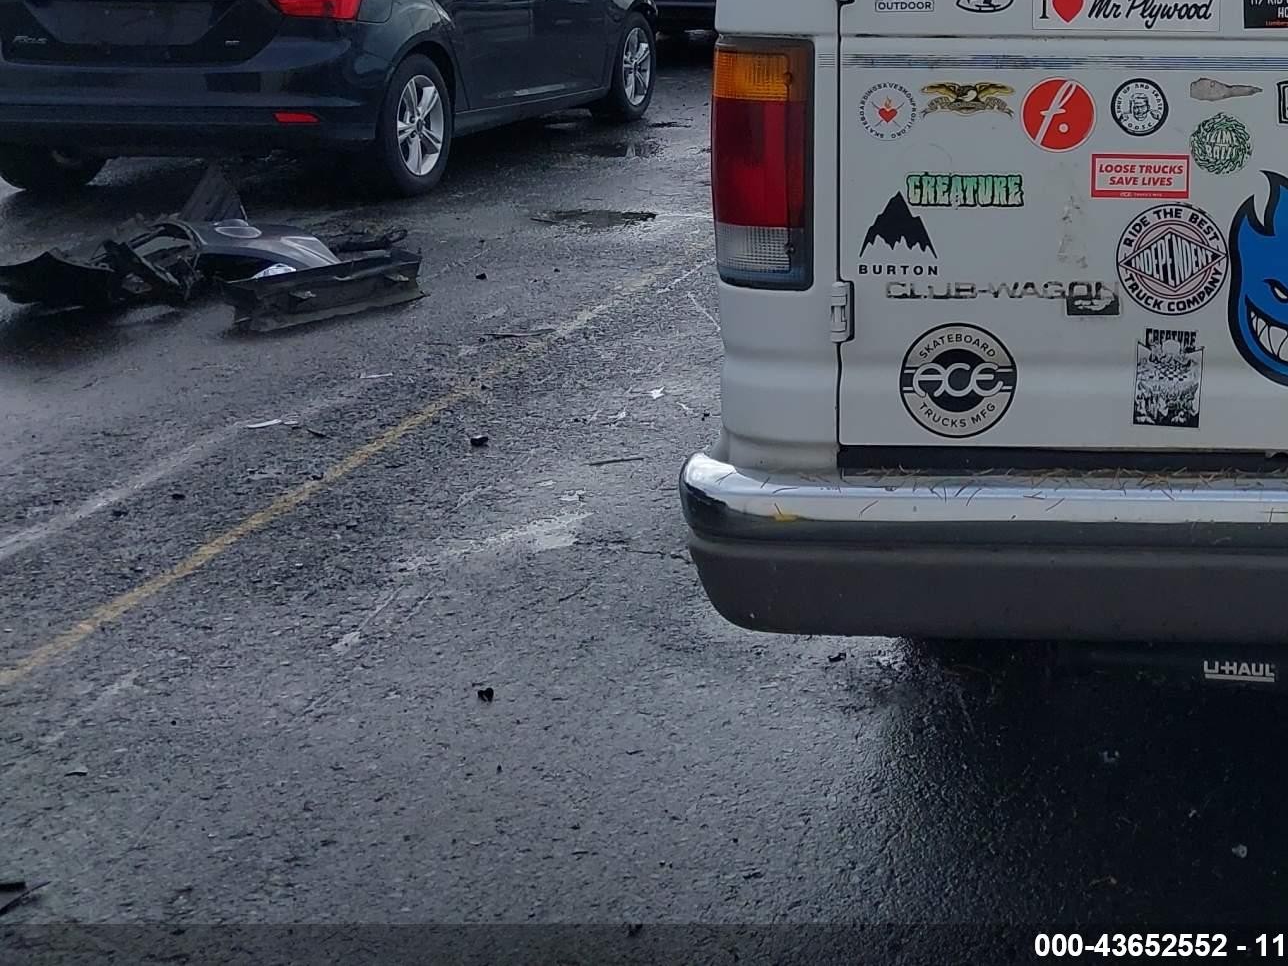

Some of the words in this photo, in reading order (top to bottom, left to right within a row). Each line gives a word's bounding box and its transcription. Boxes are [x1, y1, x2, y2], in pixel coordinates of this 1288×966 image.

[877, 0, 932, 11] OUTDOOR
[1099, 164, 1135, 174] LOOSE
[1138, 165, 1184, 174] TRUCKS
[1109, 176, 1138, 186] SAVE
[1141, 177, 1173, 186] LIVES
[907, 175, 1024, 207] CREATURE
[1123, 216, 1150, 247] RIDE
[1153, 208, 1183, 219] THE
[1188, 212, 1220, 243] BEST
[858, 264, 938, 275] BURTON
[1131, 233, 1214, 287] INDEPENDENT
[1124, 273, 1163, 311] TRUCK
[1167, 267, 1223, 312] COMPANY
[919, 333, 996, 359] SKATEBOARD
[919, 402, 967, 428] TRUCKS
[971, 402, 996, 425] MFG
[1203, 660, 1276, 677] U-HAUL
